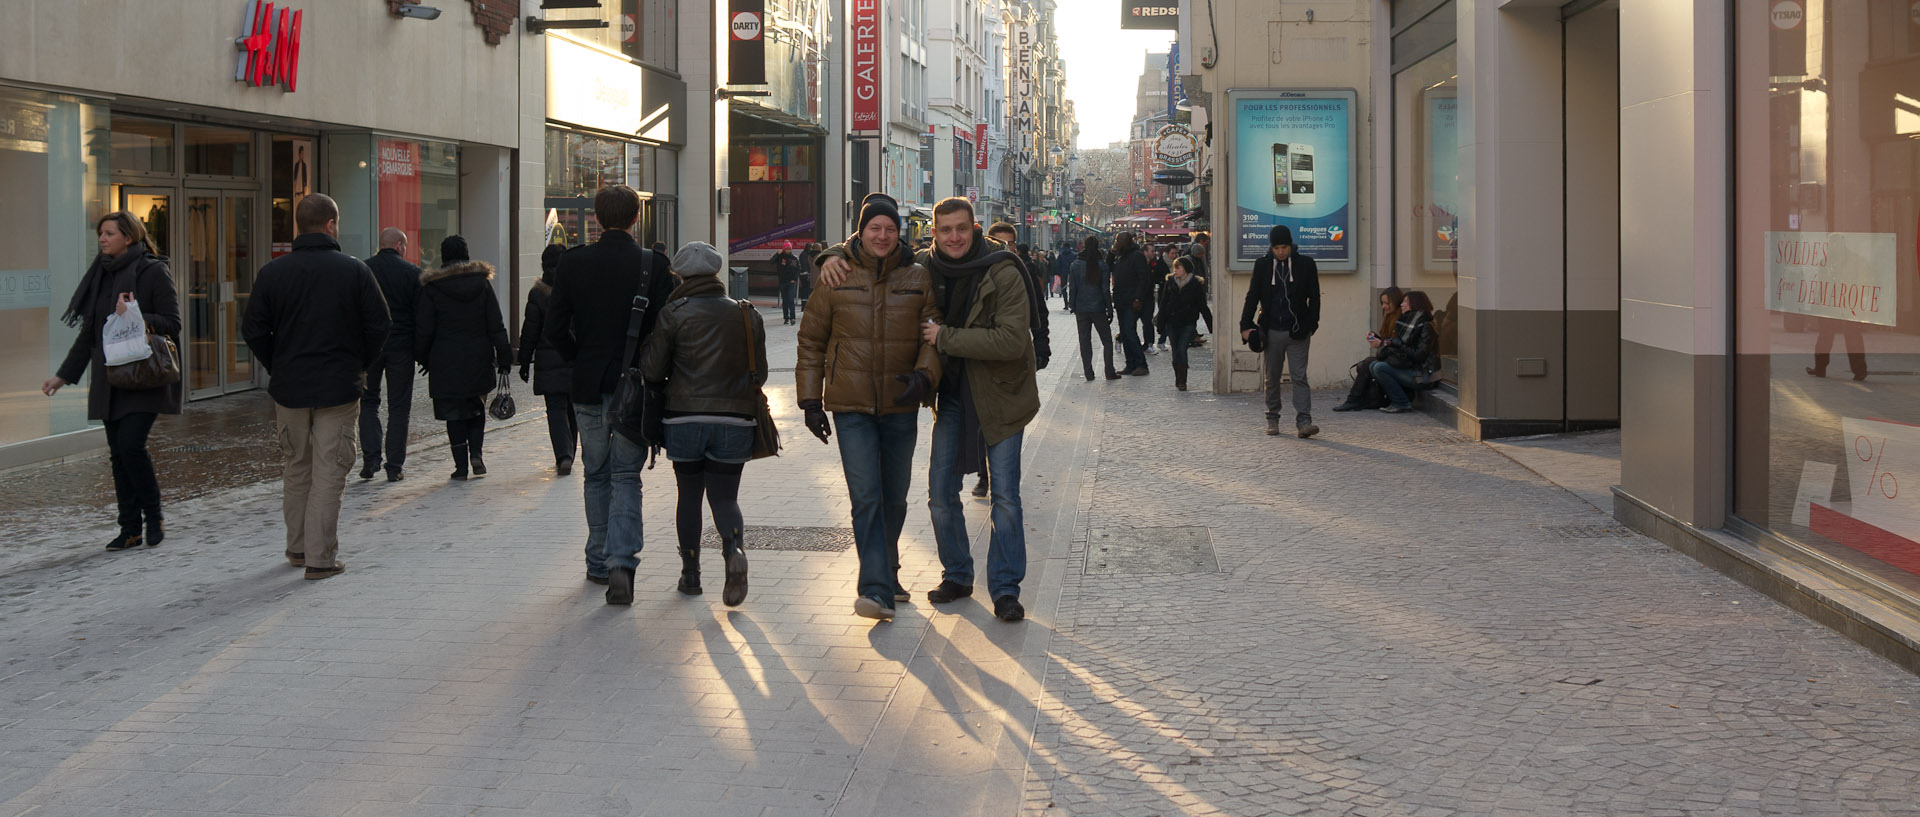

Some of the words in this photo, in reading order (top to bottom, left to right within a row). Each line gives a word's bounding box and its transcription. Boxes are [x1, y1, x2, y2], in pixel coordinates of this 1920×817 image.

[733, 22, 760, 31] DARTY
[240, 0, 303, 93] H&M
[1018, 31, 1032, 165] BENJAMIN
[381, 147, 411, 162] NOUVELLE
[1159, 152, 1193, 163] BRASSERIE
[1299, 226, 1327, 234] Bouygues
[1776, 240, 1829, 267] SOLDES
[1797, 274, 1882, 316] DÉMARQUE
